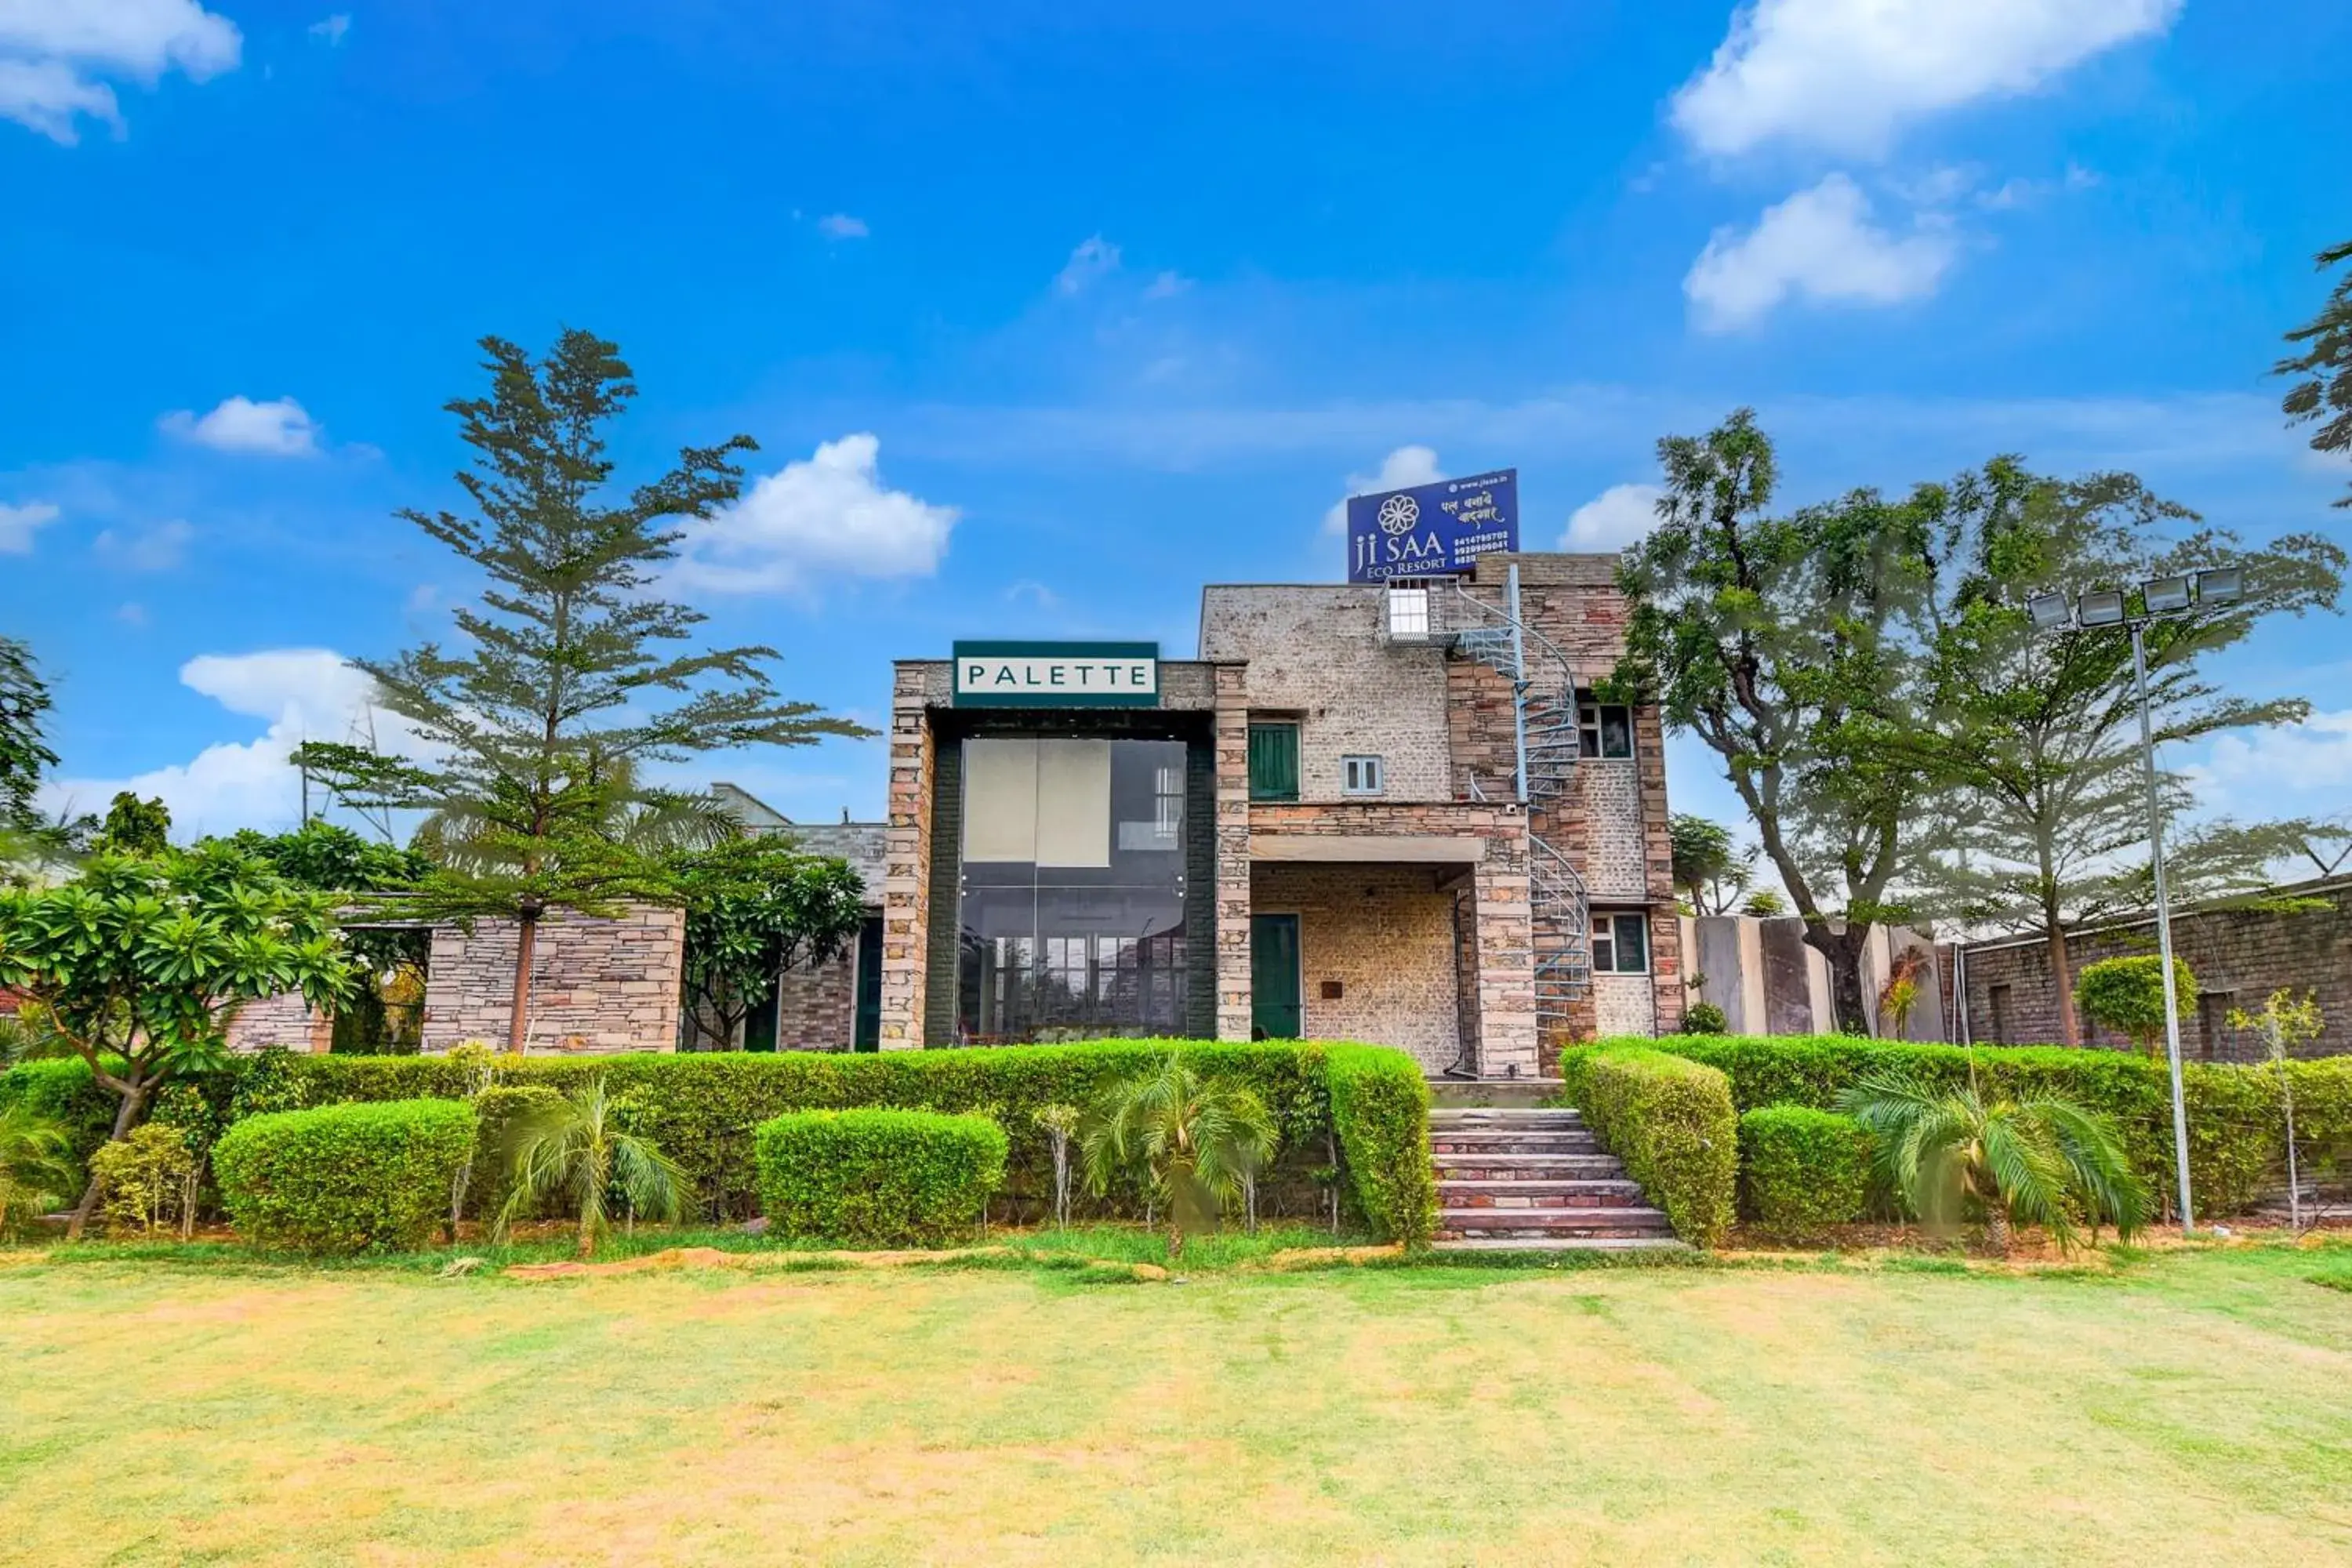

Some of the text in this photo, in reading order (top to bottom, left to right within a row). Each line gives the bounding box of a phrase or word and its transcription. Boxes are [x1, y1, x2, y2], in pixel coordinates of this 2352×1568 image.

[1386, 531, 1445, 563] SAA
[1367, 557, 1448, 579] ECO RESORT
[969, 665, 1145, 685] PALETTE
